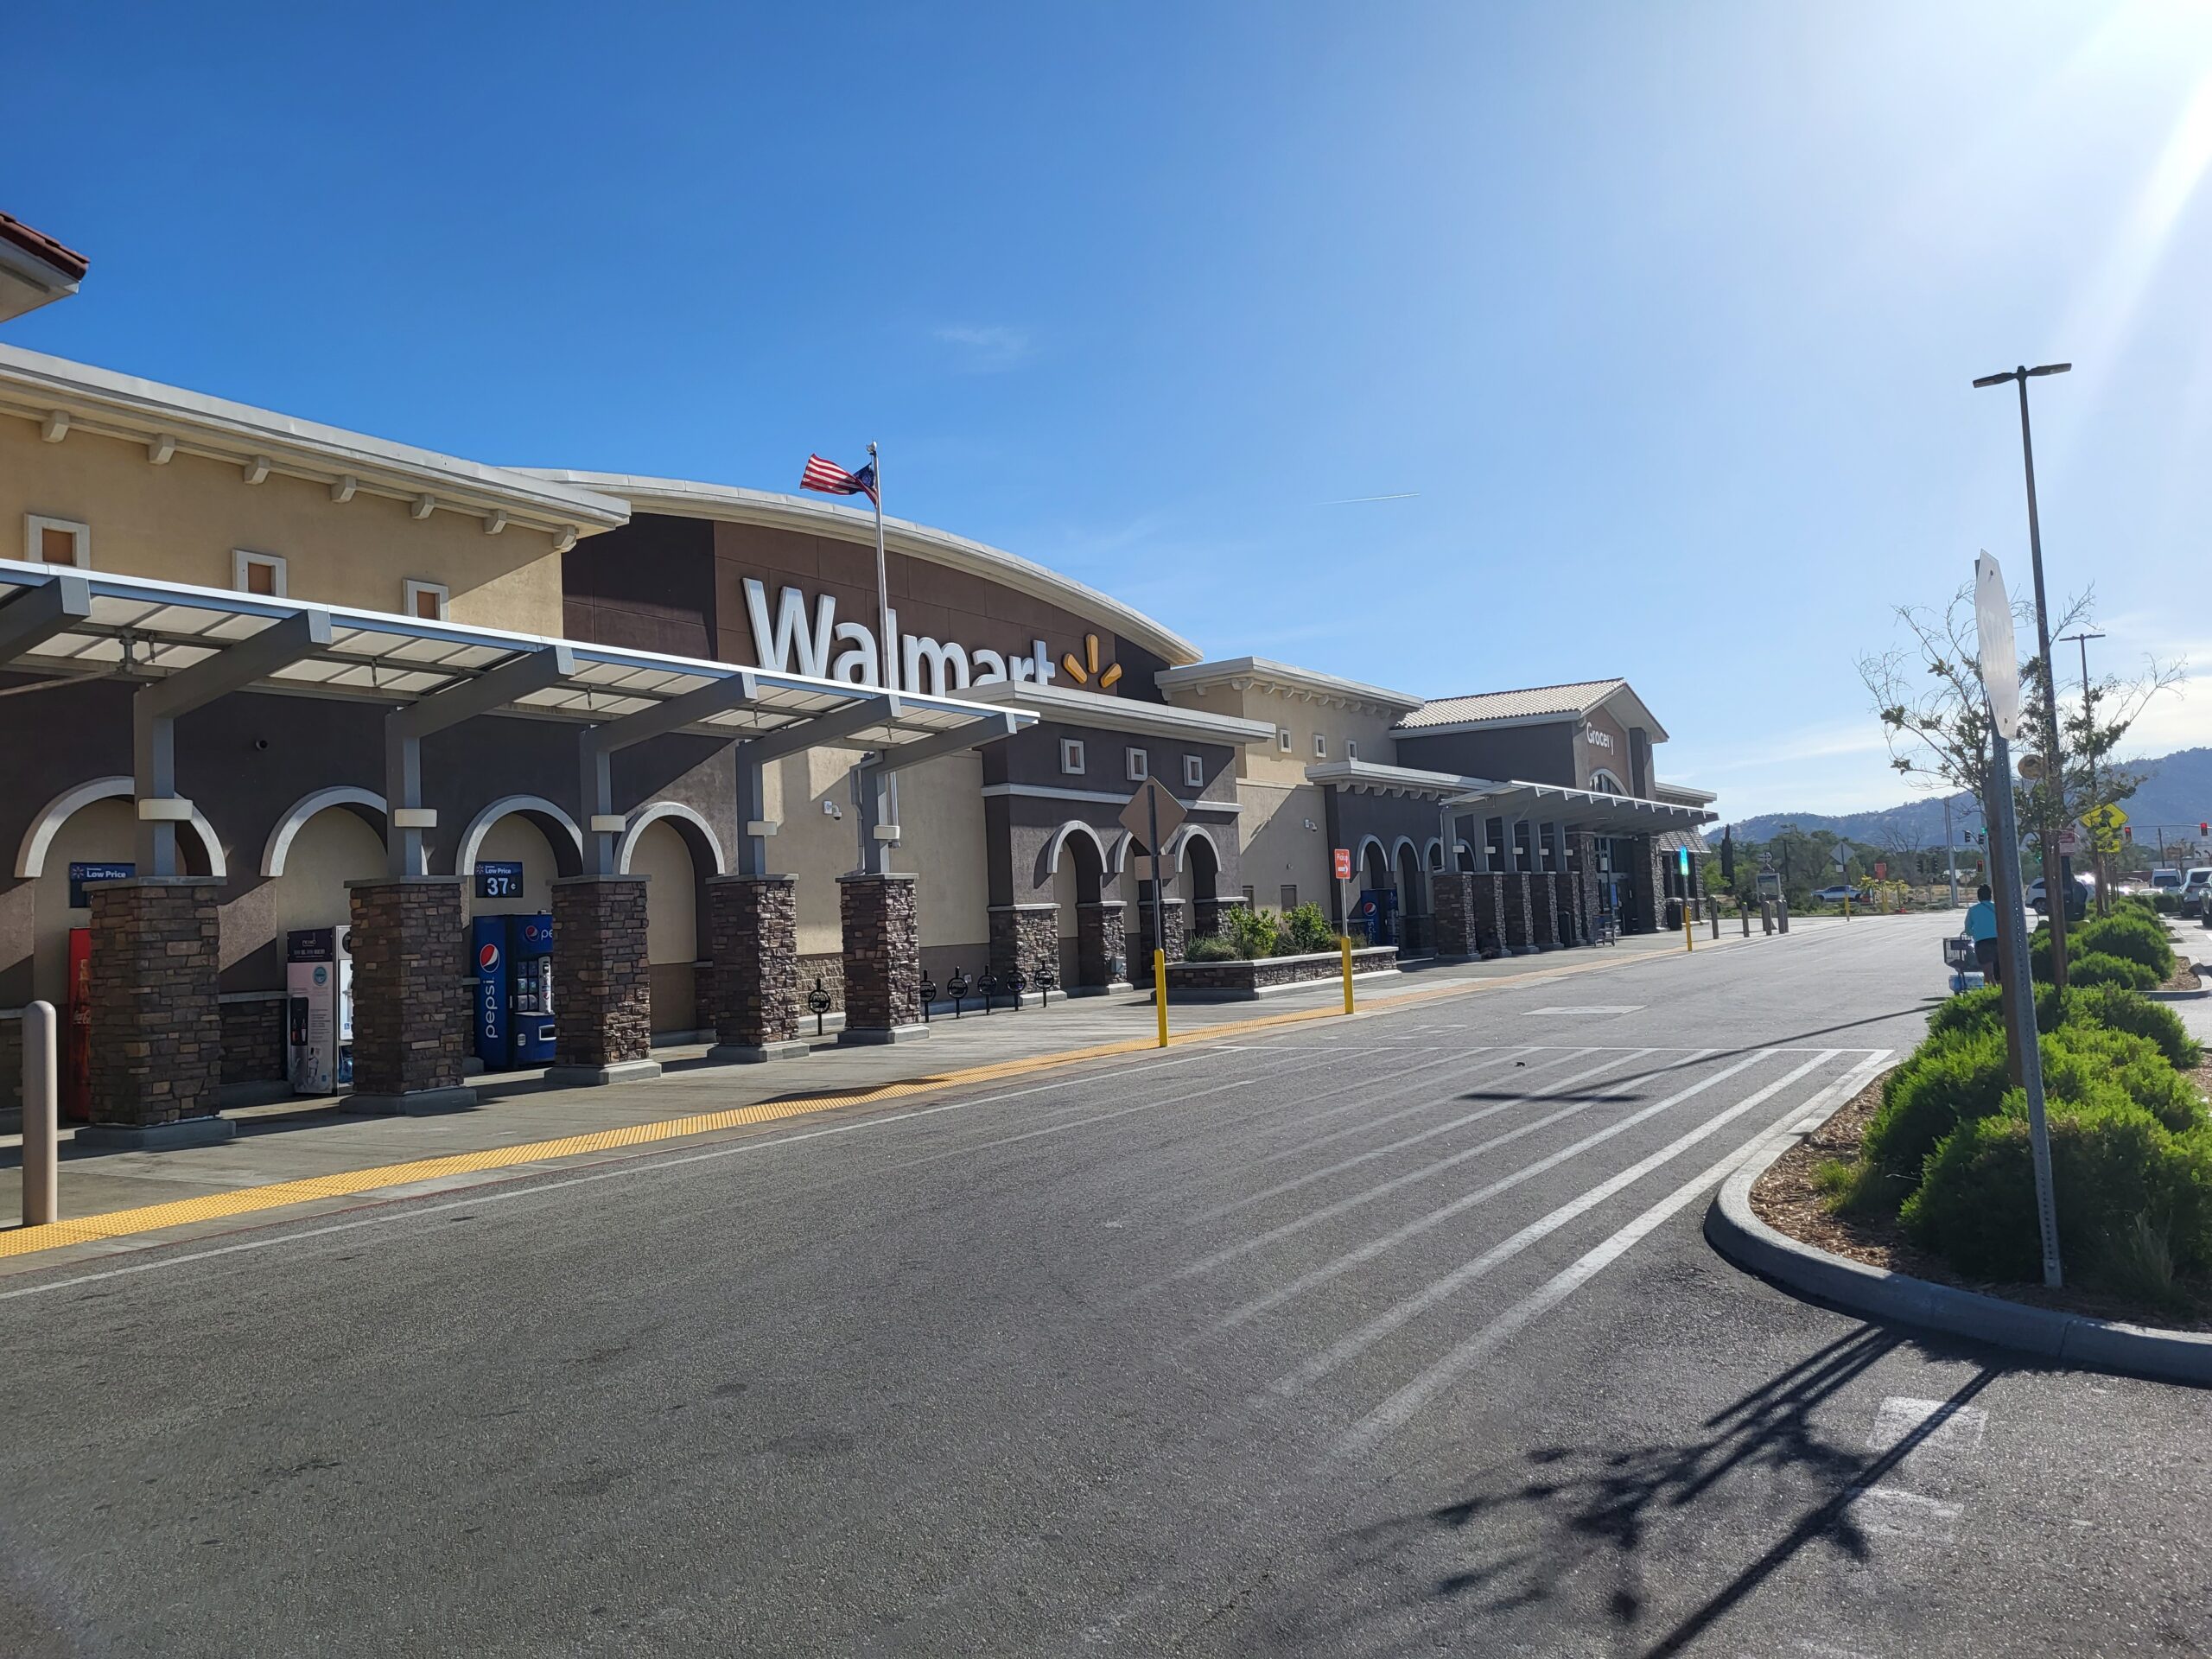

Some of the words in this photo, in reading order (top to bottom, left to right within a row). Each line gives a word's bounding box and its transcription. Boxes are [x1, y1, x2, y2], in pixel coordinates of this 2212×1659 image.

[742, 577, 1056, 696] Walmart
[1586, 721, 1613, 756] Grocery
[483, 978, 498, 1039] pepsi
